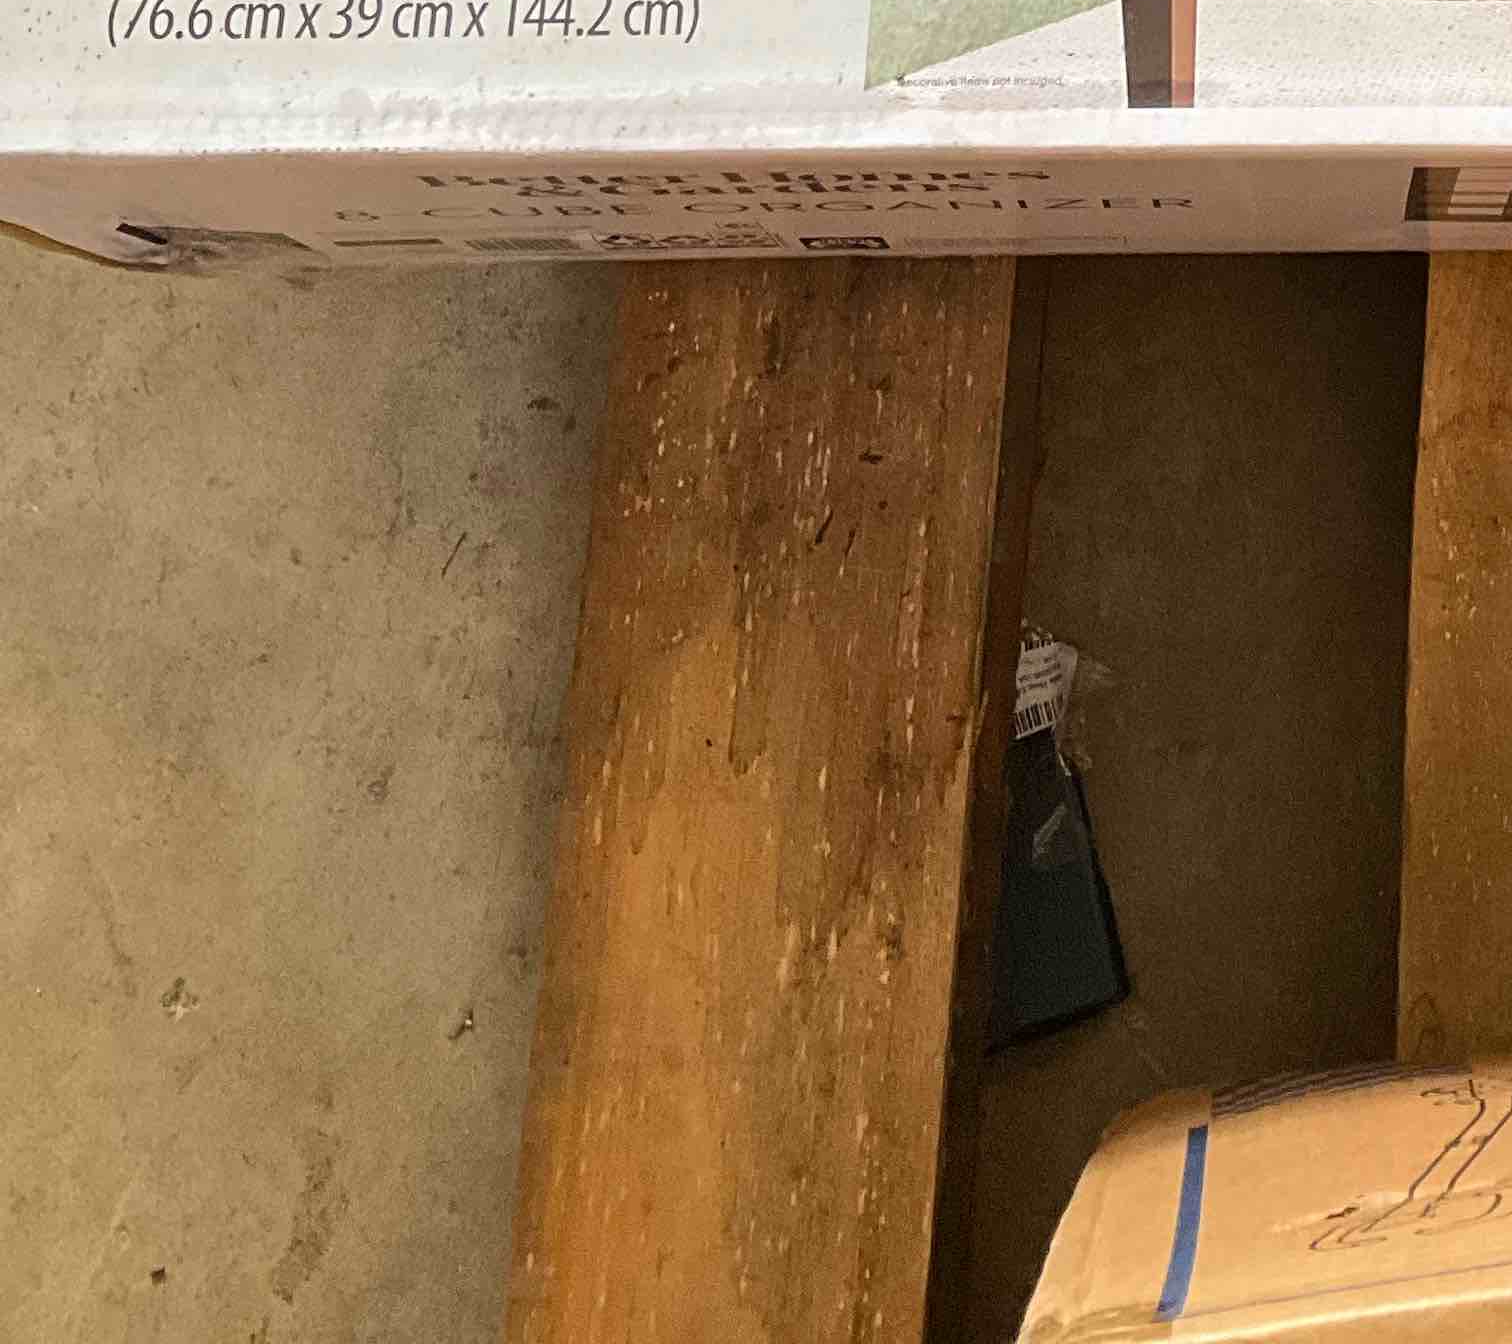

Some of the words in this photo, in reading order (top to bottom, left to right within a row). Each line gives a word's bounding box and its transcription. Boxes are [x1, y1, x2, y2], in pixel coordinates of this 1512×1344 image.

[224, 2, 285, 39] cm
[294, 3, 322, 39] x
[392, 2, 453, 38] cm
[462, 2, 489, 37] x
[684, 197, 1194, 214] ORGANIZER
